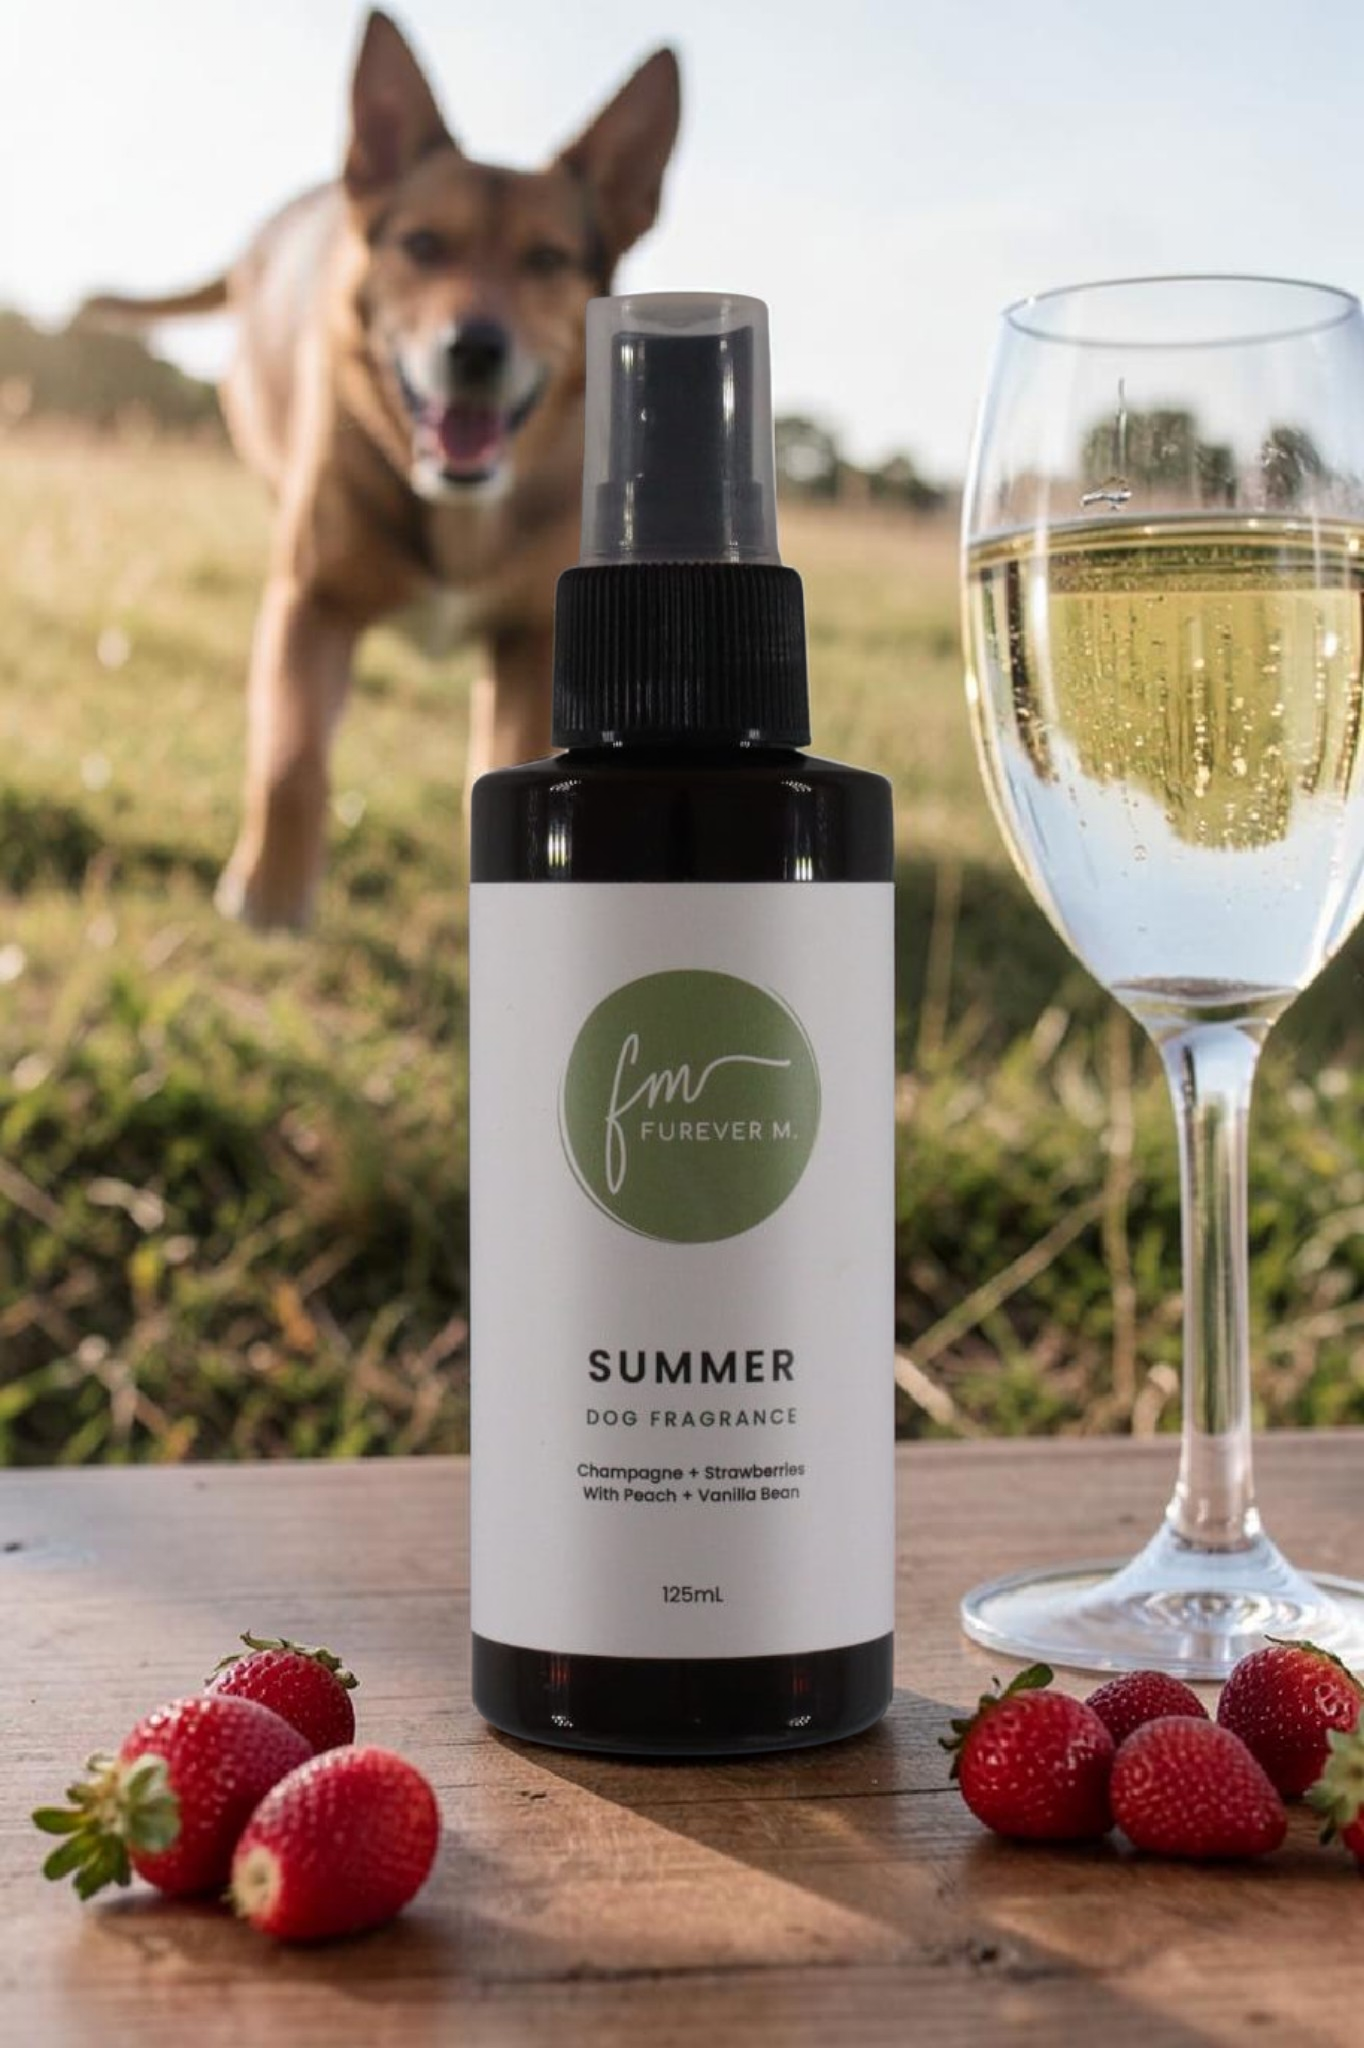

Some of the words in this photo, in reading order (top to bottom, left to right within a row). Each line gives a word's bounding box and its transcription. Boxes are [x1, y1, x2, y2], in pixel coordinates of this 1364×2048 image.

[640, 1121, 762, 1141] FUREVER
[772, 1121, 798, 1140] M.
[588, 1349, 795, 1384] SUMMER
[586, 1408, 638, 1427] DOG
[650, 1408, 798, 1428] FRAGRANCE
[577, 1463, 684, 1484] Champagne
[705, 1461, 806, 1480] Strawberries
[583, 1486, 620, 1501] With
[624, 1487, 677, 1503] Peach
[698, 1486, 757, 1502] Vanilla
[761, 1486, 800, 1501] Bean
[662, 1585, 724, 1604] 125mL
